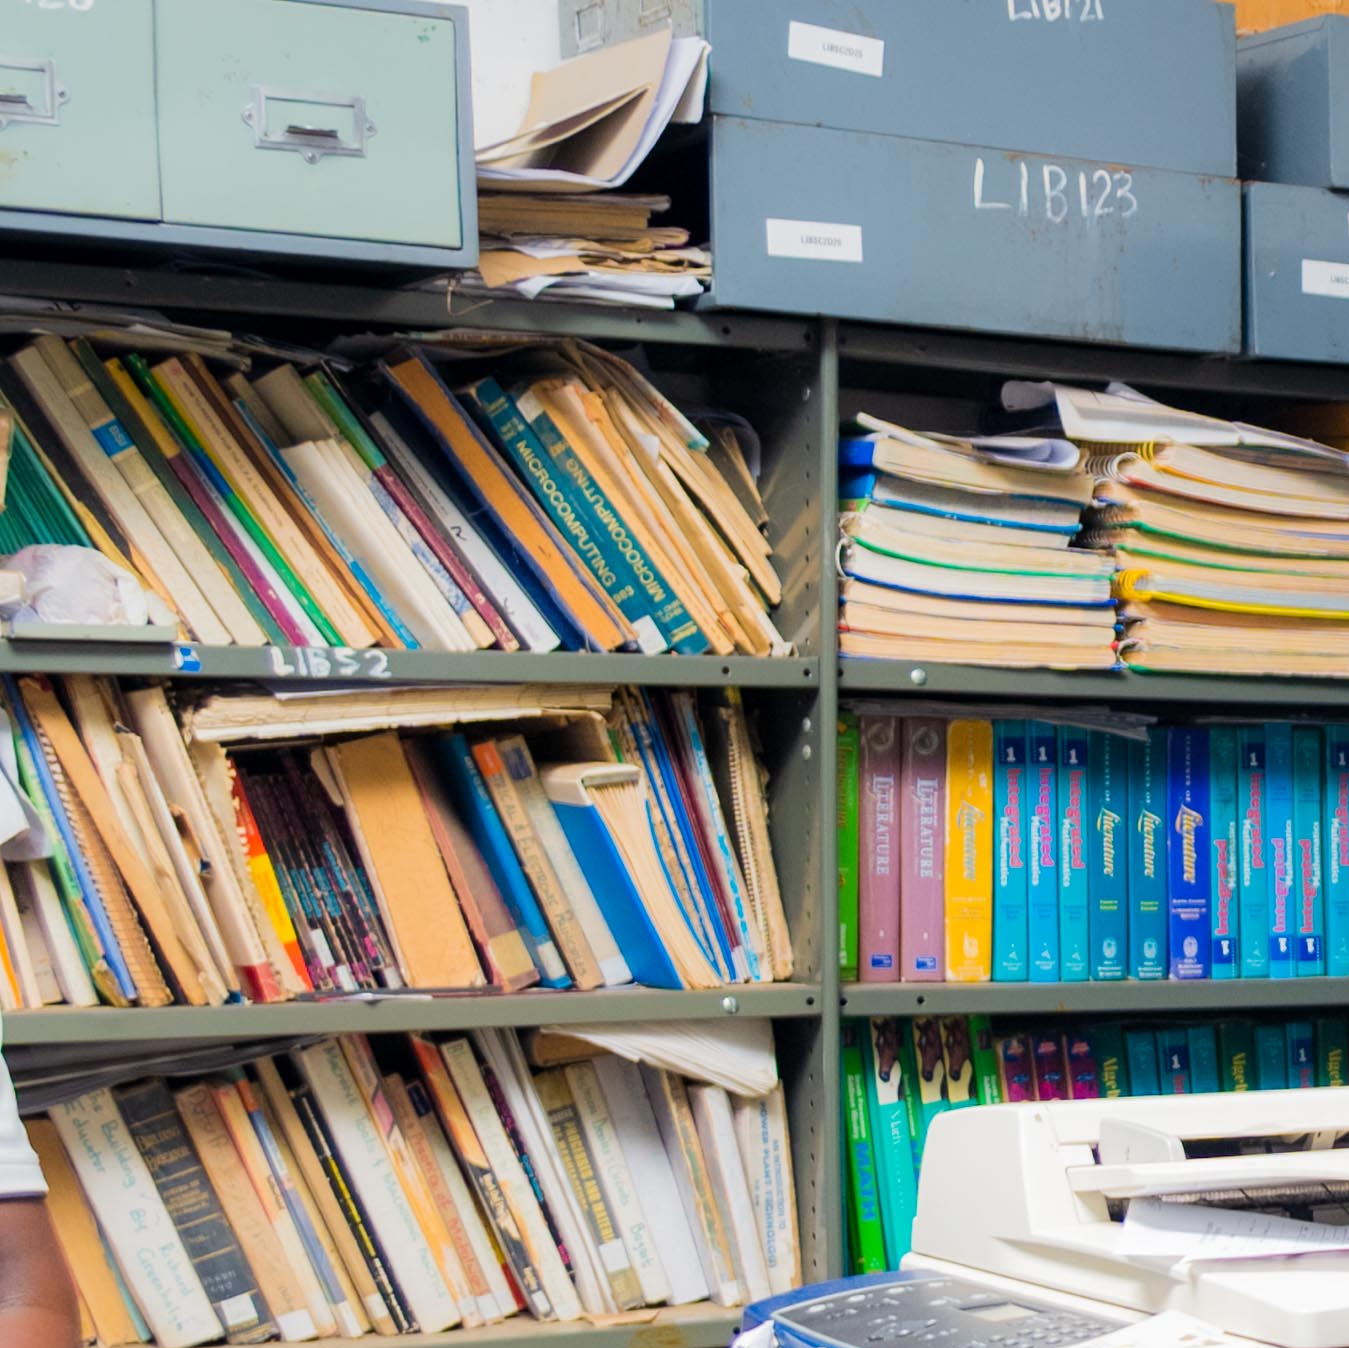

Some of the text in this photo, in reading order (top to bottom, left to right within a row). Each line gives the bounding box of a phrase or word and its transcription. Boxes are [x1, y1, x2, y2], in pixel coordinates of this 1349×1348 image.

[973, 157, 1138, 223] LIB123
[516, 439, 616, 586] MICROCOMPUTING
[566, 458, 666, 602] MICROCOMPUTING
[872, 774, 896, 877] LITERATURE
[915, 777, 940, 879] LITERATURE
[1003, 767, 1024, 869] Integrated
[1035, 767, 1055, 868] Integrated
[1065, 770, 1086, 870] Integrated
[1097, 807, 1121, 878] Literature
[1137, 808, 1162, 879] Literature
[1175, 802, 1204, 885] Literature
[1246, 772, 1265, 869] Integrated
[1213, 838, 1233, 937] Integrated
[1270, 836, 1289, 933] Integrated
[1298, 838, 1318, 933] Integrated
[97, 1117, 143, 1189] Building
[760, 1147, 773, 1186] PLANT
[770, 1153, 786, 1216] INTRODUCTION
[850, 1140, 880, 1221] MATH
